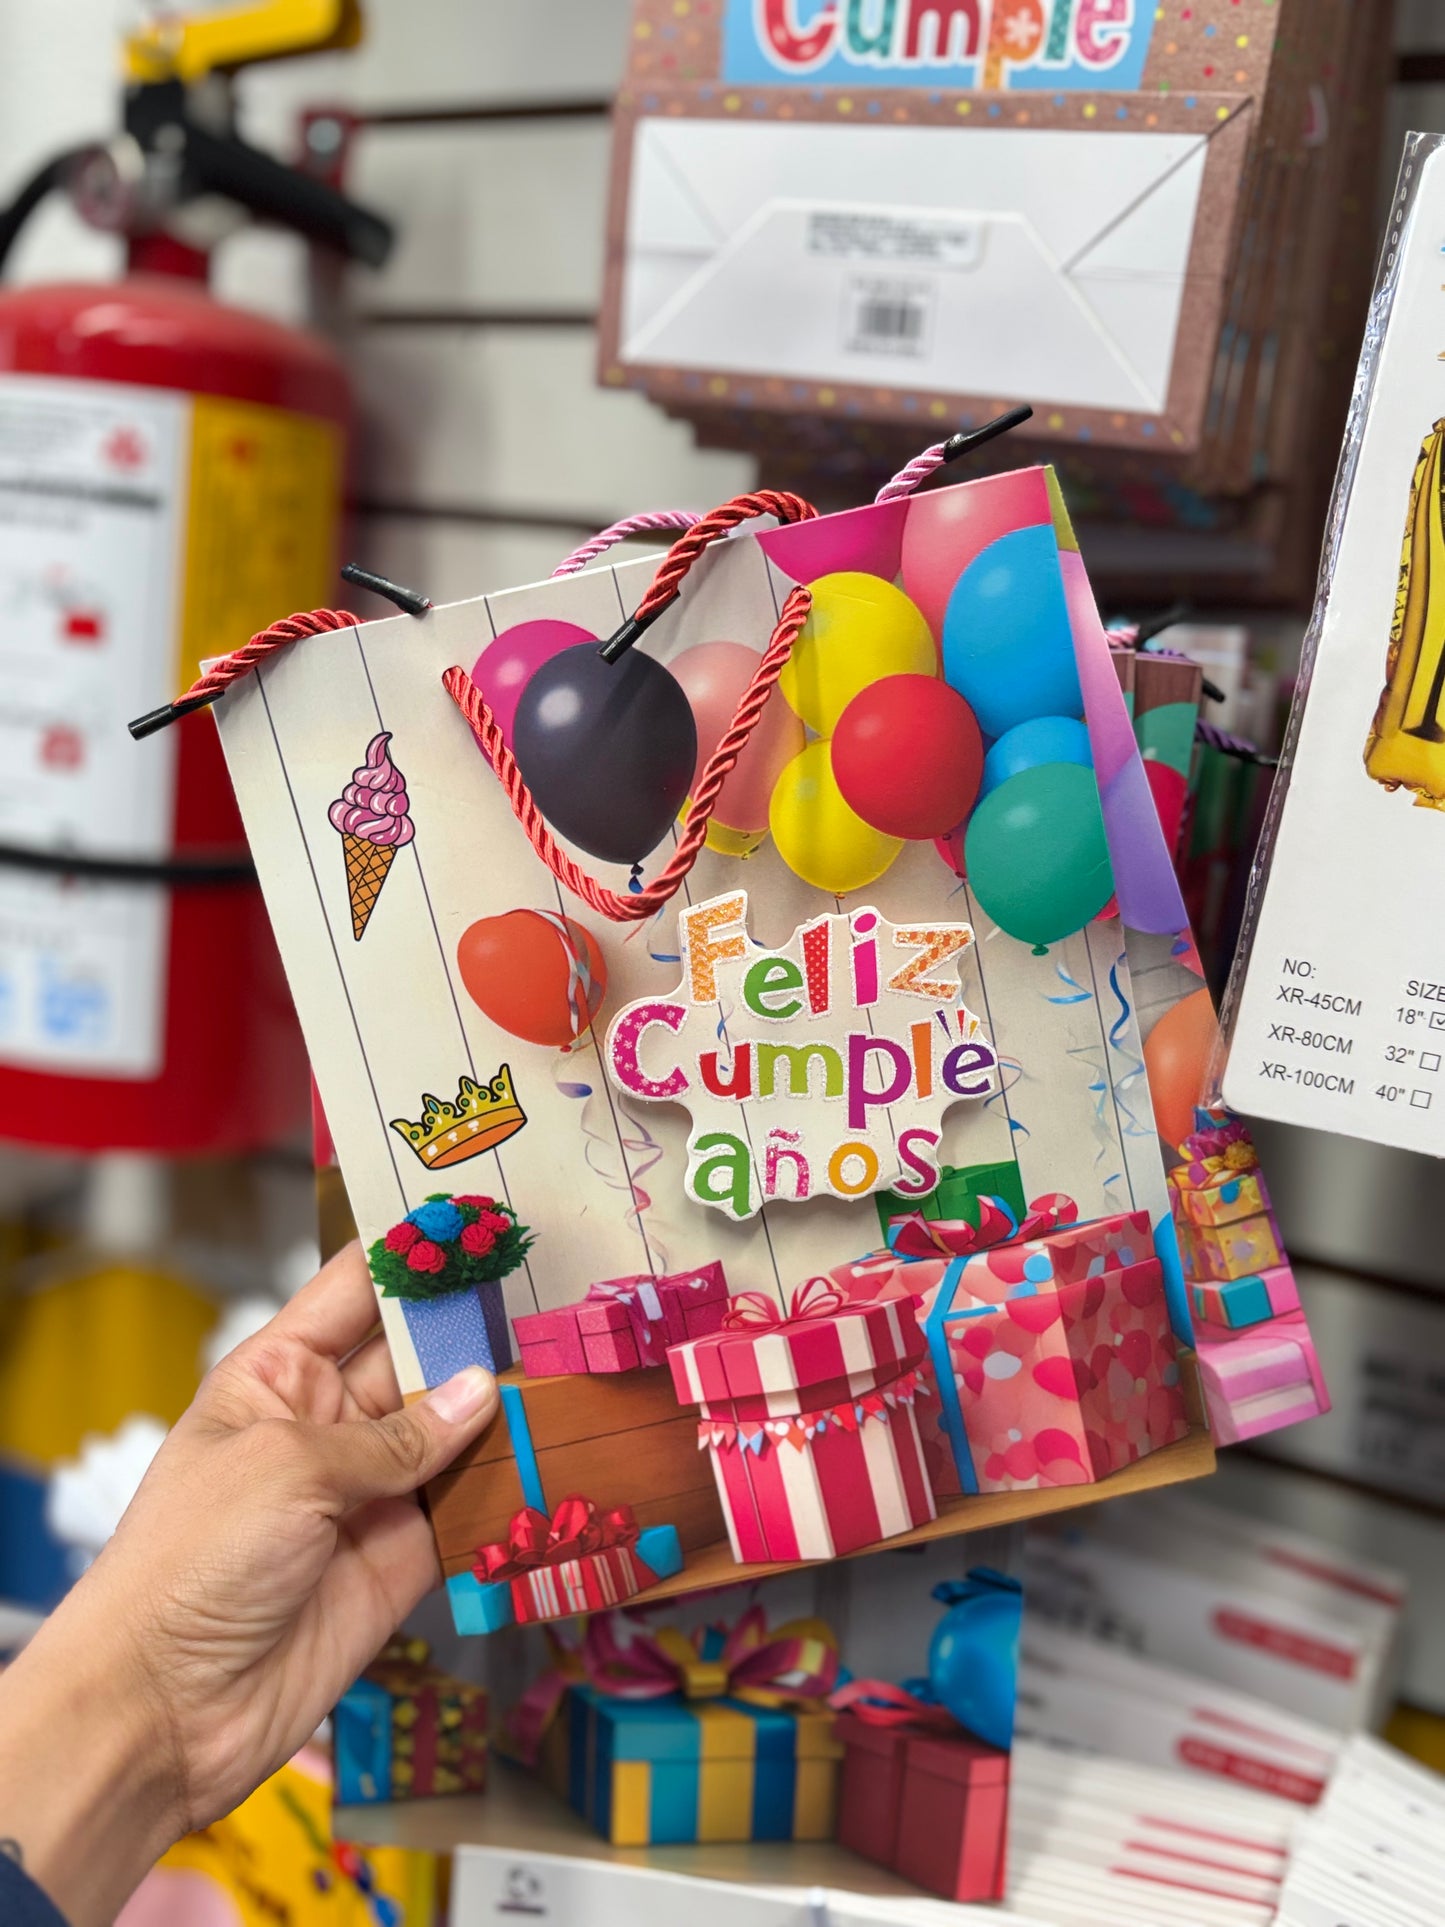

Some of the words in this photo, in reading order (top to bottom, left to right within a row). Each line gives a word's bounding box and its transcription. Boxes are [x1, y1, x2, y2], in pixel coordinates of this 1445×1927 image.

[685, 895, 974, 1019] Feliz
[1281, 958, 1317, 979] NO:
[1275, 984, 1363, 1017] XR-45CM
[1396, 1007, 1425, 1025] 18"
[1267, 1023, 1353, 1055] XR-80CM
[1384, 1045, 1415, 1064] 32"
[611, 1003, 997, 1129] Cumple
[1258, 1060, 1355, 1095] XR-100CM
[1374, 1084, 1406, 1102] 40"
[693, 1127, 941, 1216] años
